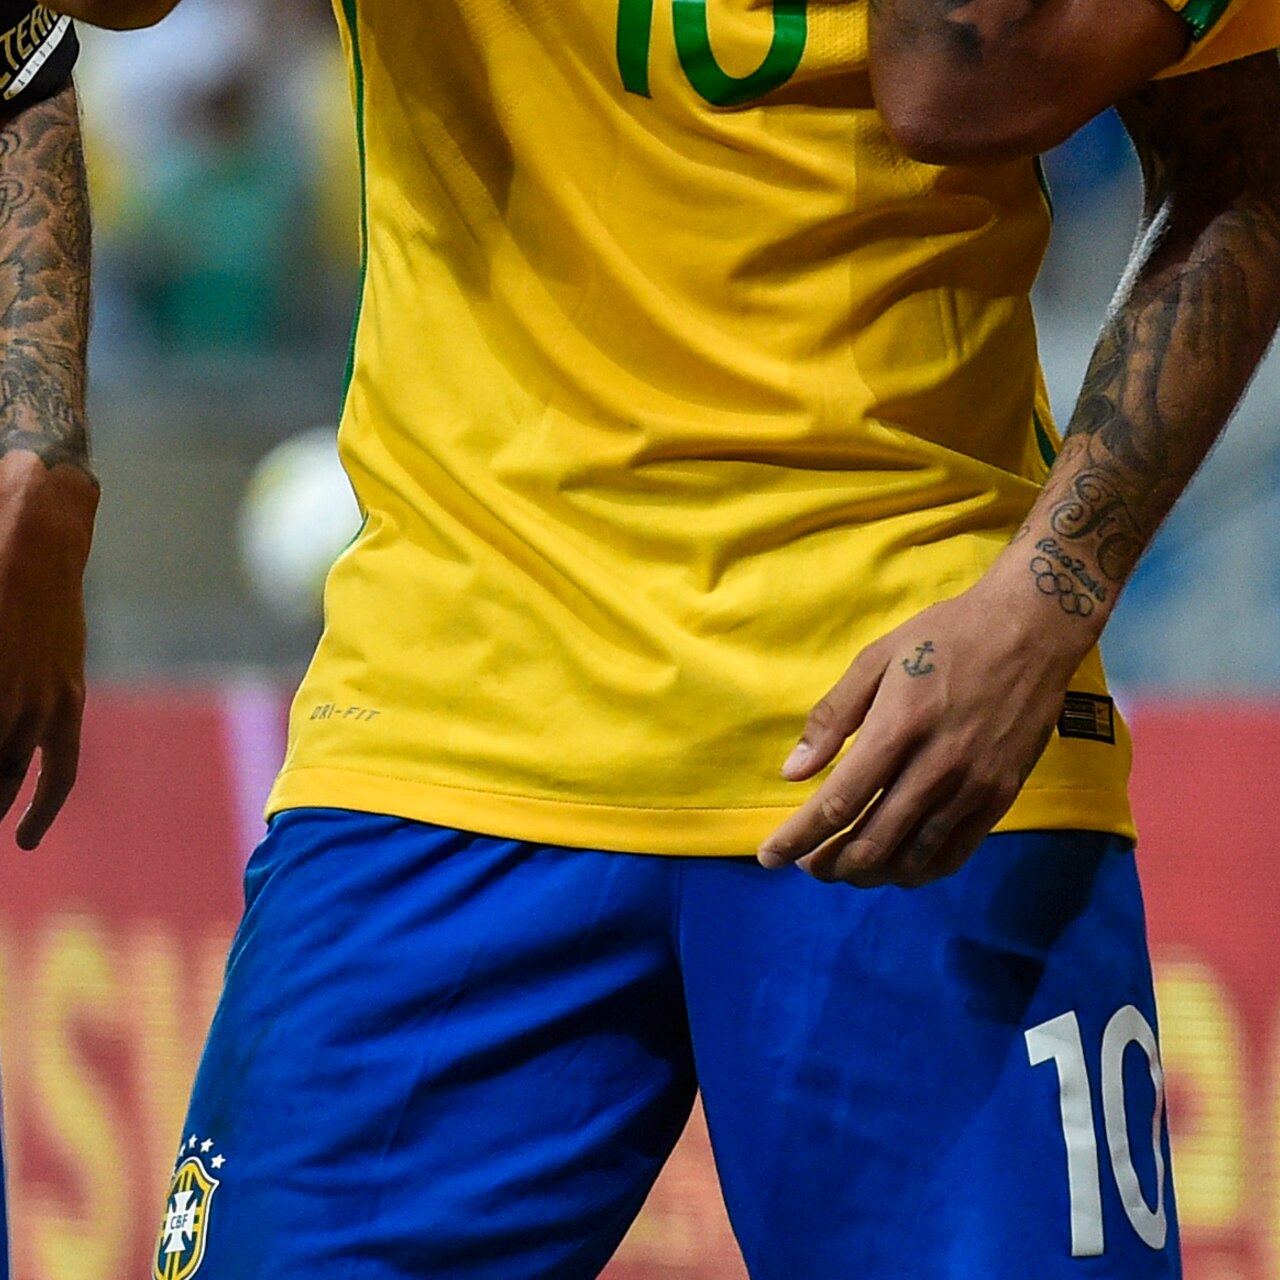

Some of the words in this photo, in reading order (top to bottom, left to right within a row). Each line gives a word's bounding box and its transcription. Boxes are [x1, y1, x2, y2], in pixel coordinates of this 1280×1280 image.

[309, 703, 381, 722] DRI-FIT
[1023, 1004, 1168, 1258] 10
[169, 1213, 189, 1230] CBF
